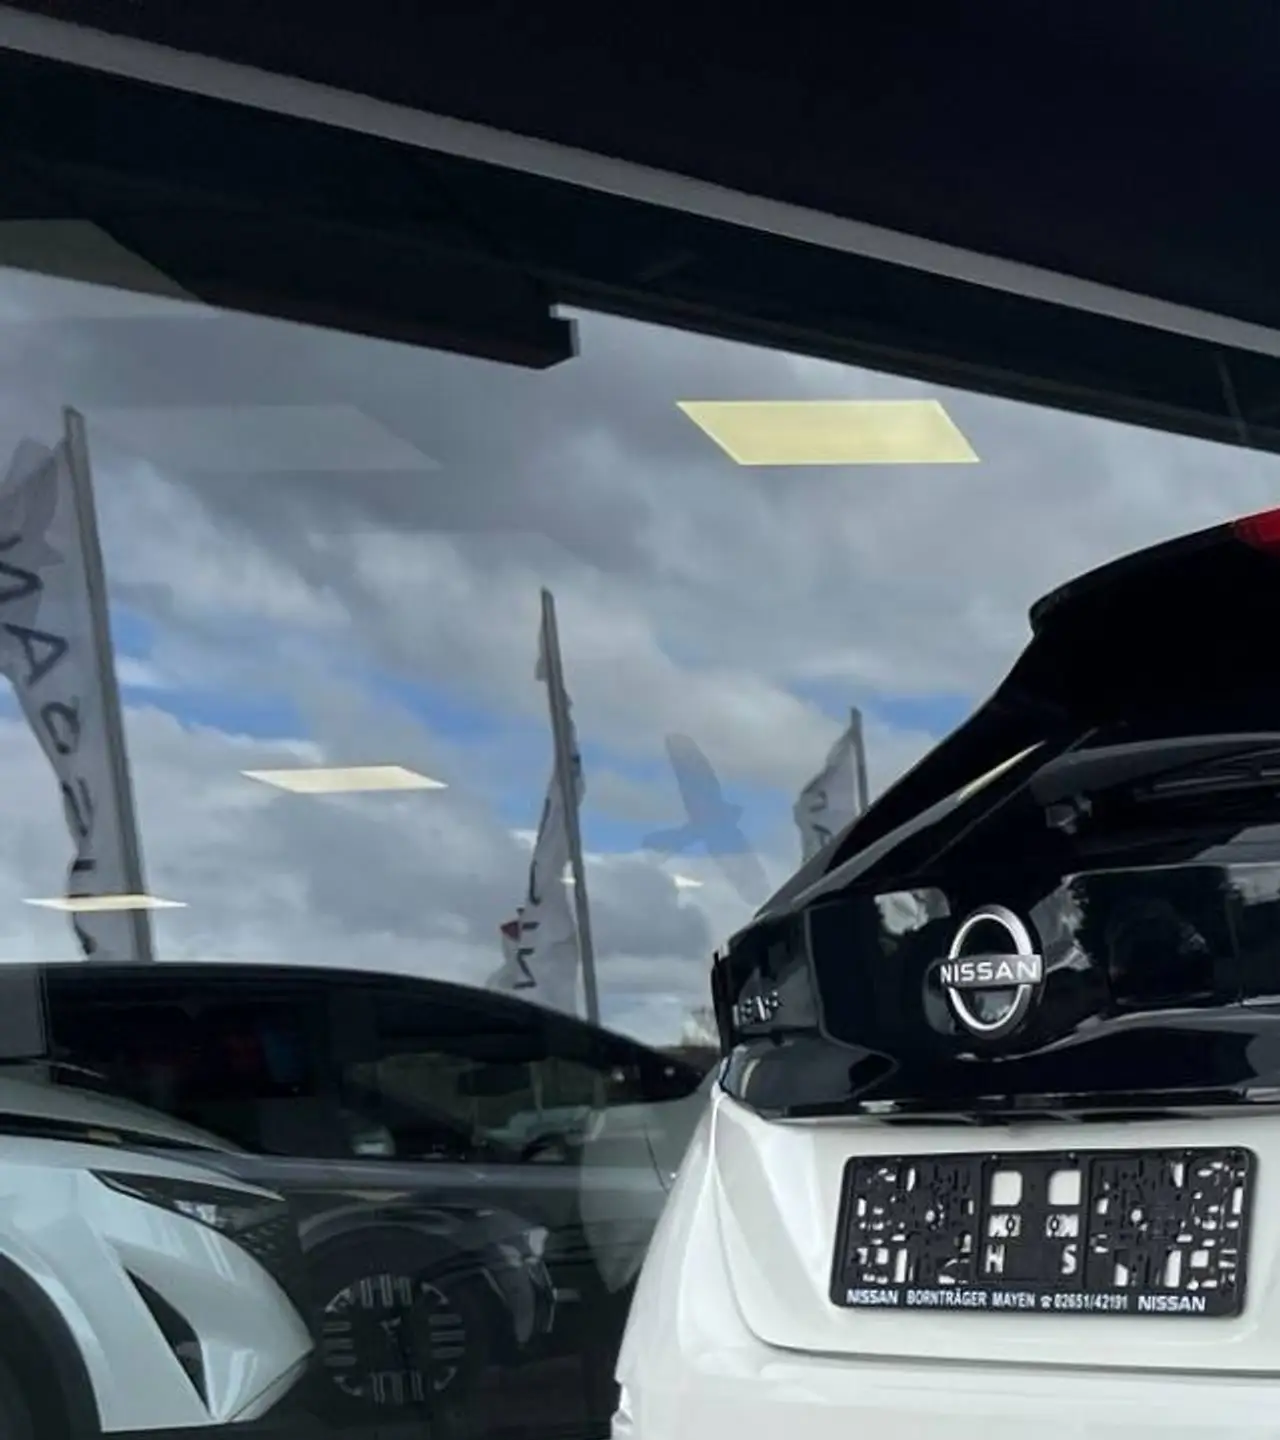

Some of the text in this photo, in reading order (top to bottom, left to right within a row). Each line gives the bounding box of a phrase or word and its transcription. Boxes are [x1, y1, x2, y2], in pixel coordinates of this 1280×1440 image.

[939, 959, 1038, 984] NISSAN
[846, 1288, 899, 1305] NISSAN
[906, 1288, 988, 1307] BORNTRÄGER
[991, 1291, 1036, 1309] MAYEN
[1138, 1295, 1206, 1312] NISSAN
